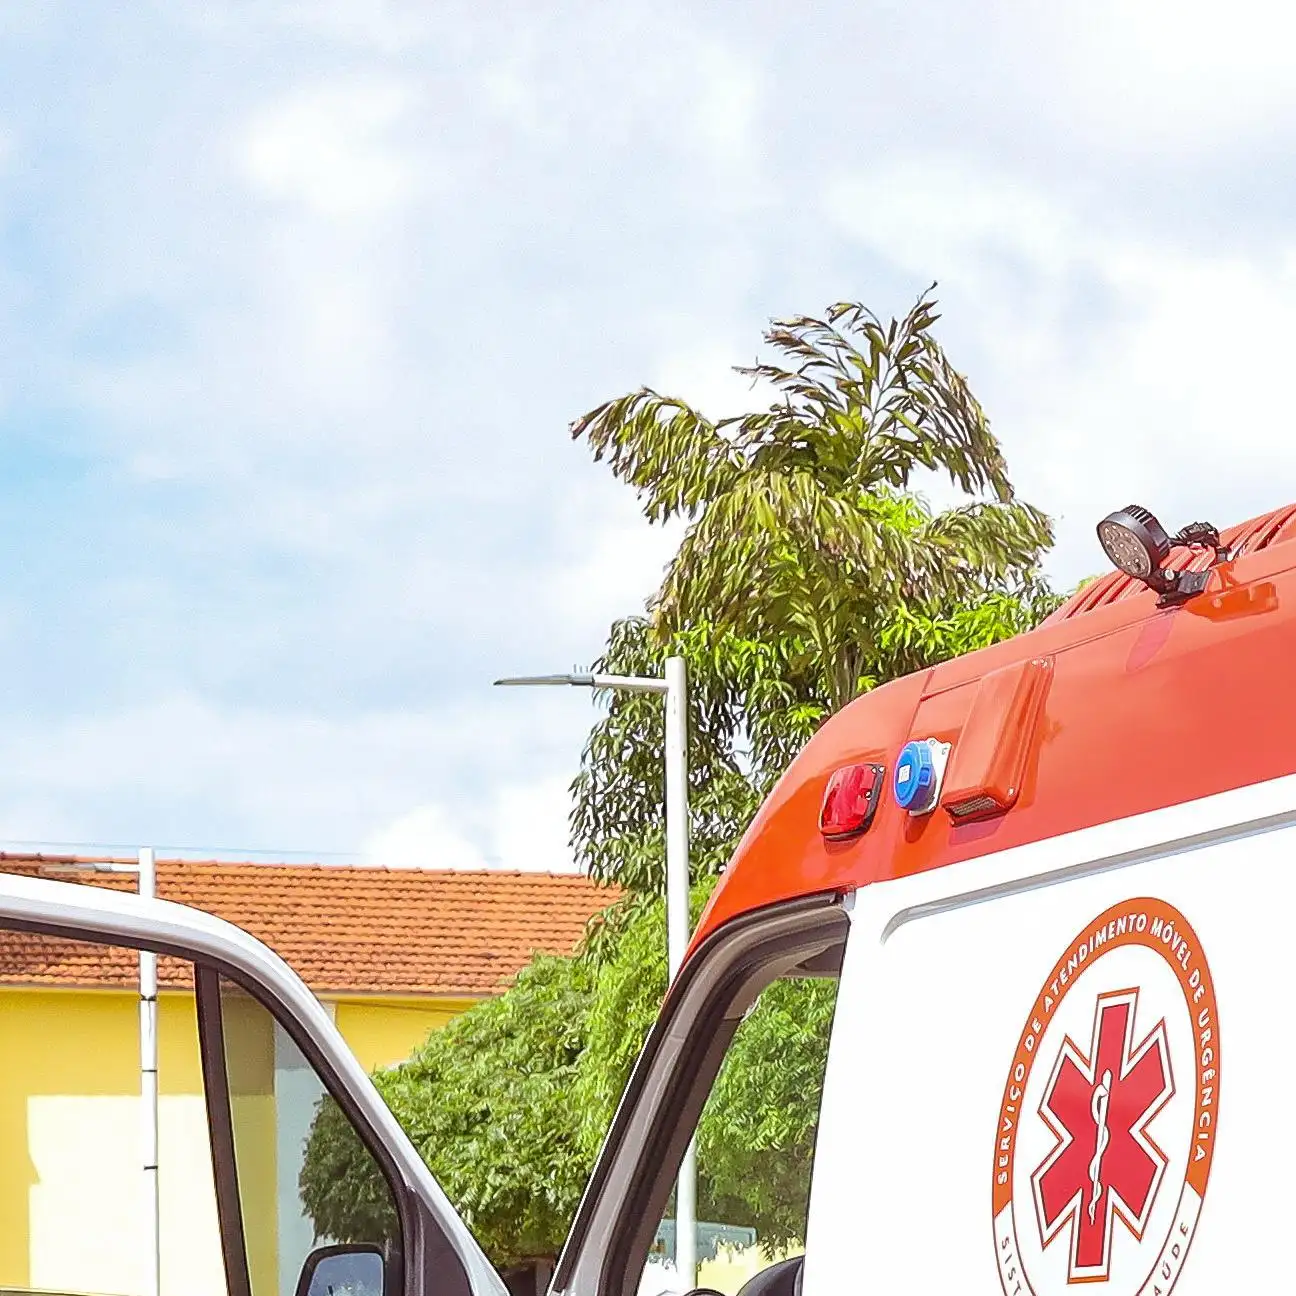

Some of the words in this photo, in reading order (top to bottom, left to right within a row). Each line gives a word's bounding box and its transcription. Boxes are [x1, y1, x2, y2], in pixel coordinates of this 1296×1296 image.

[1043, 912, 1147, 1013] ATENDIMENTO
[1149, 920, 1192, 971] MÓVEL
[1188, 967, 1205, 1005] DE
[1024, 1017, 1042, 1051] DE
[1193, 1007, 1216, 1163] URGÊNCIA
[996, 1063, 1025, 1185] SERVIÇO
